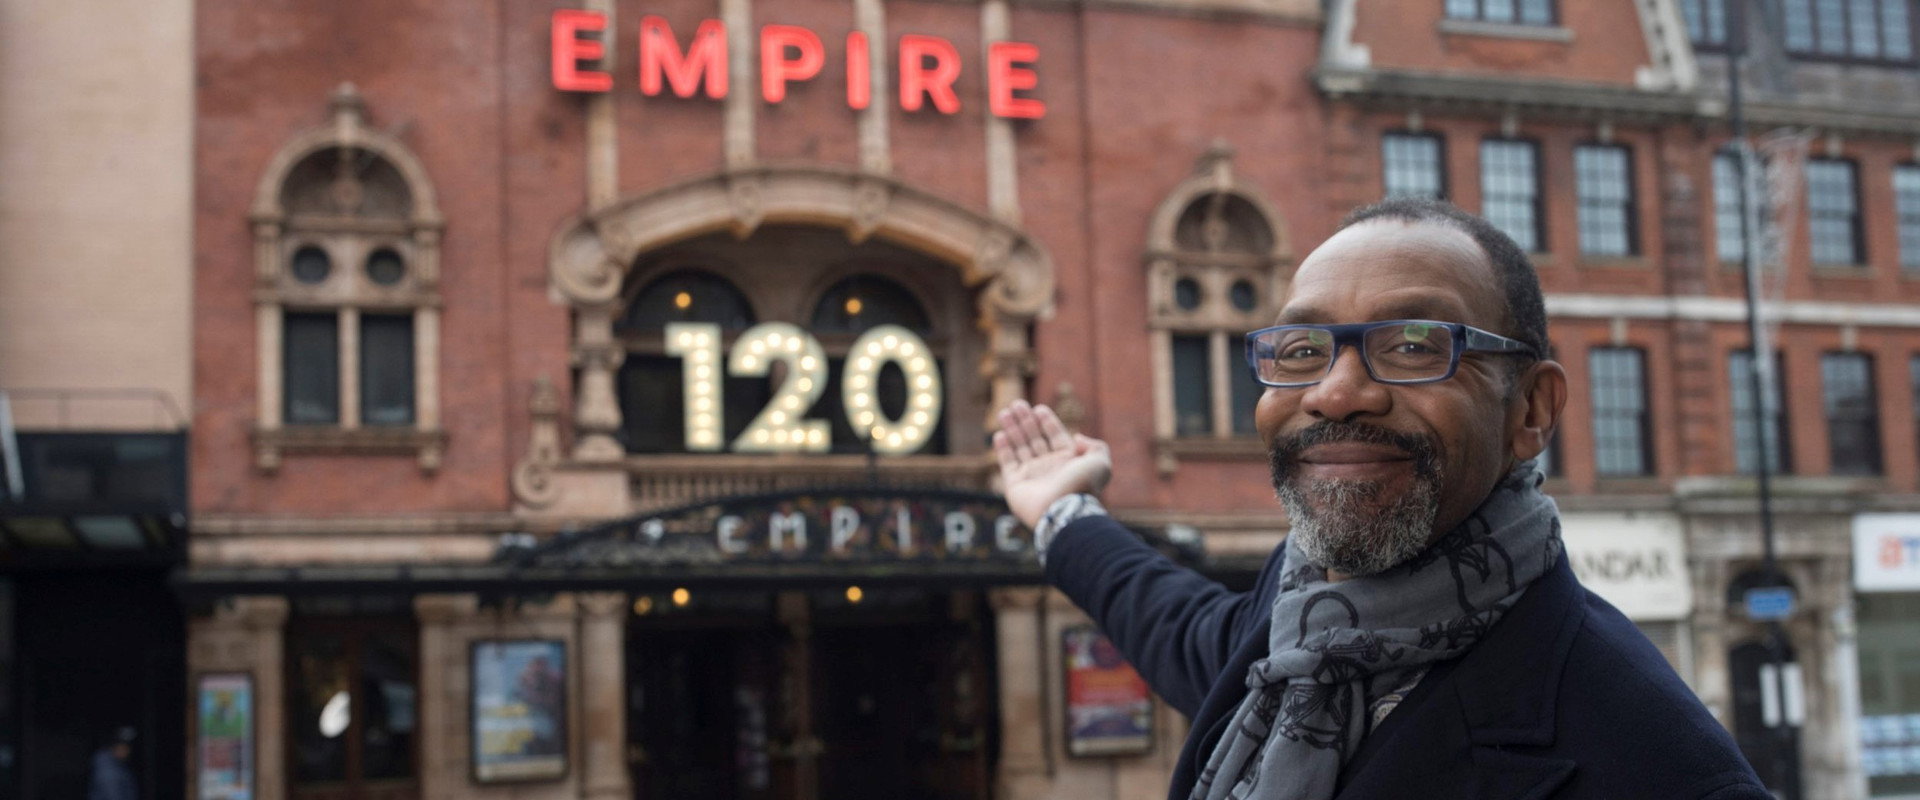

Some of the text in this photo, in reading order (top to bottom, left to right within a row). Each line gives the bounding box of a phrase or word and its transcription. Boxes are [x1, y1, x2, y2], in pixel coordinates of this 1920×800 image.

[552, 10, 1046, 118] EMPIRE
[664, 321, 941, 455] 120
[716, 506, 1025, 553] EMPIRE
